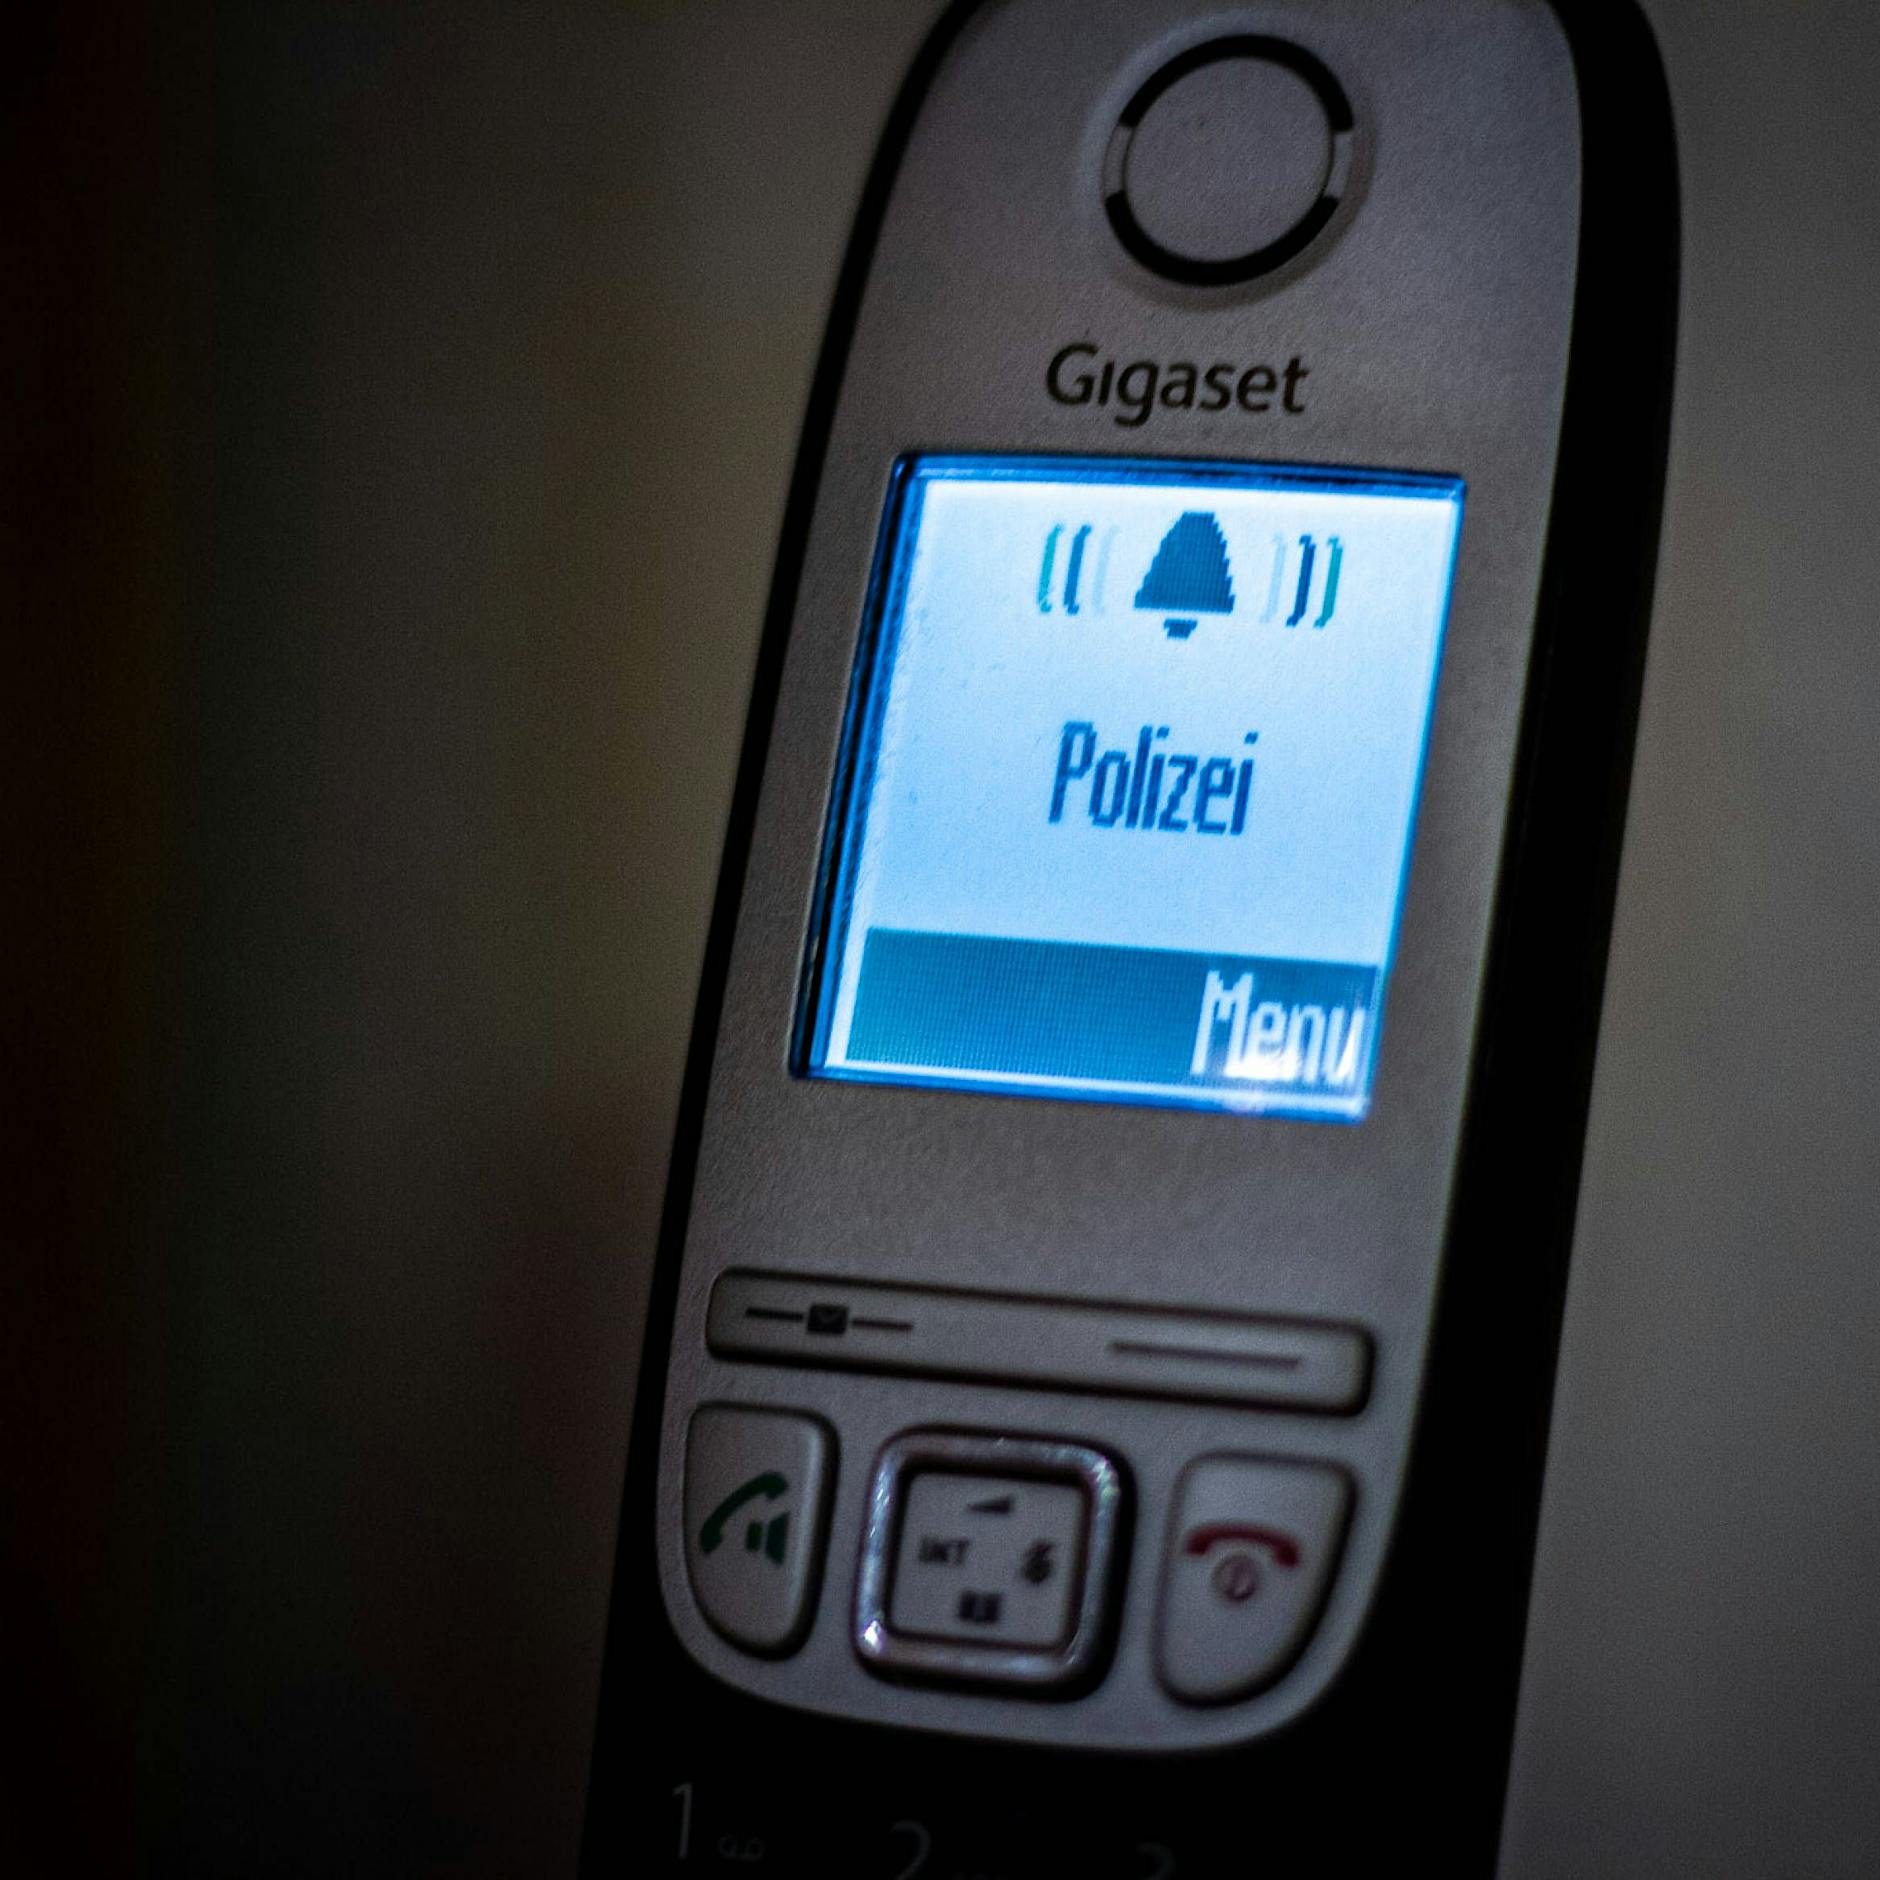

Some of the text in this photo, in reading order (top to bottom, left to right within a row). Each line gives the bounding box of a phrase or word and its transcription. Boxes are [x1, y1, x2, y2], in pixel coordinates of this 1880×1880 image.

[1046, 344, 1309, 426] Gigaset
[1048, 721, 1259, 836] Polizei
[1190, 969, 1367, 1086] Menu
[671, 1780, 694, 1860] 1
